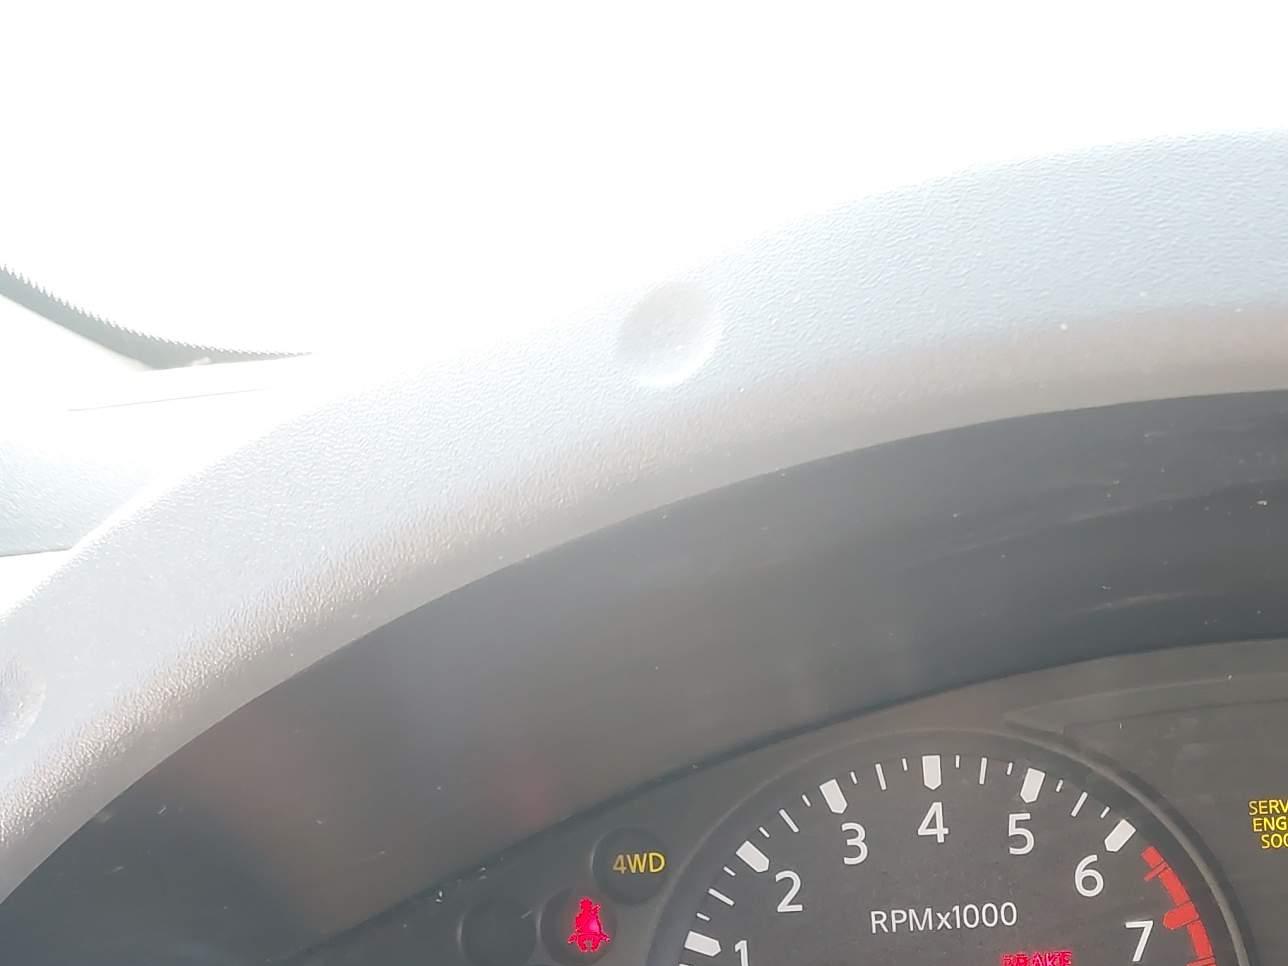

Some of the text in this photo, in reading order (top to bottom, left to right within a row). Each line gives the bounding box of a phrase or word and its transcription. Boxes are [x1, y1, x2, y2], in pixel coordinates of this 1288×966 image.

[843, 823, 869, 865] 3
[917, 803, 949, 843] 4
[1009, 813, 1035, 856] 5
[612, 851, 666, 875] 4WD
[1075, 854, 1104, 897] 6
[775, 871, 803, 913] 2
[871, 902, 1018, 934] RPMx1000
[1125, 920, 1155, 962] 7
